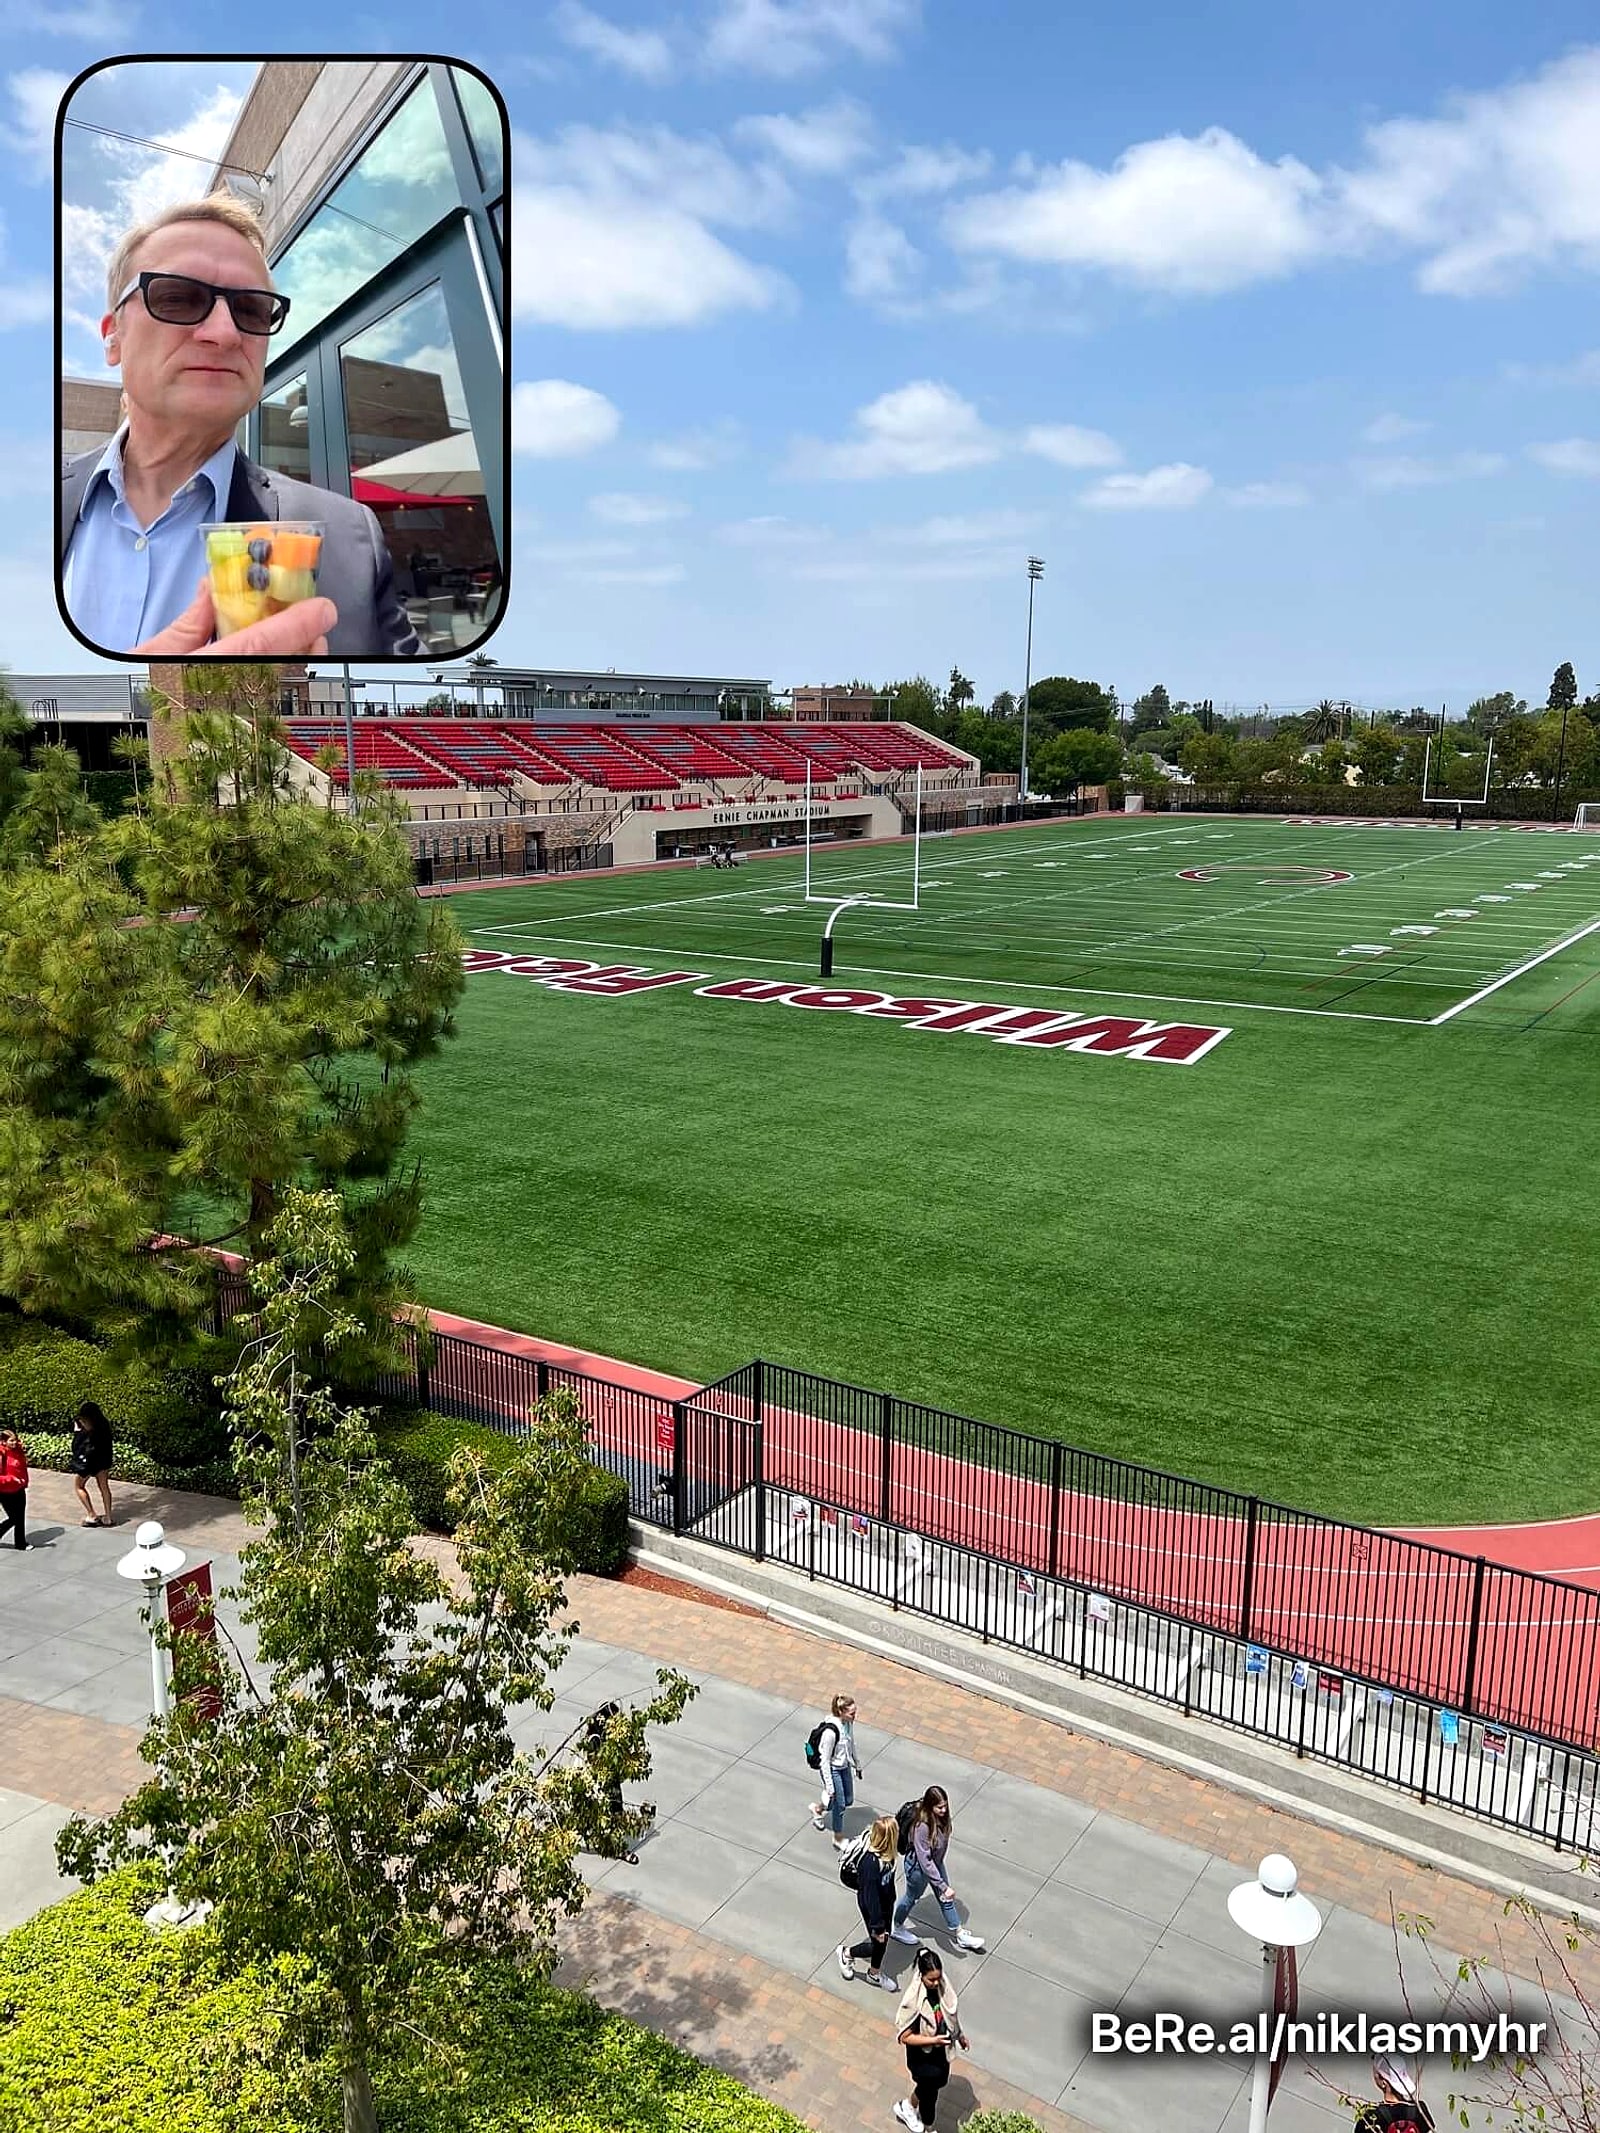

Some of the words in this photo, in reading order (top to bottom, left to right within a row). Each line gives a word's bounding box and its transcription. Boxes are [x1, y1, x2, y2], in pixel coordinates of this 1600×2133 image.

[713, 812, 740, 823] ERNIE
[746, 808, 789, 820] CHAPMAN
[693, 979, 1233, 1065] Wilson
